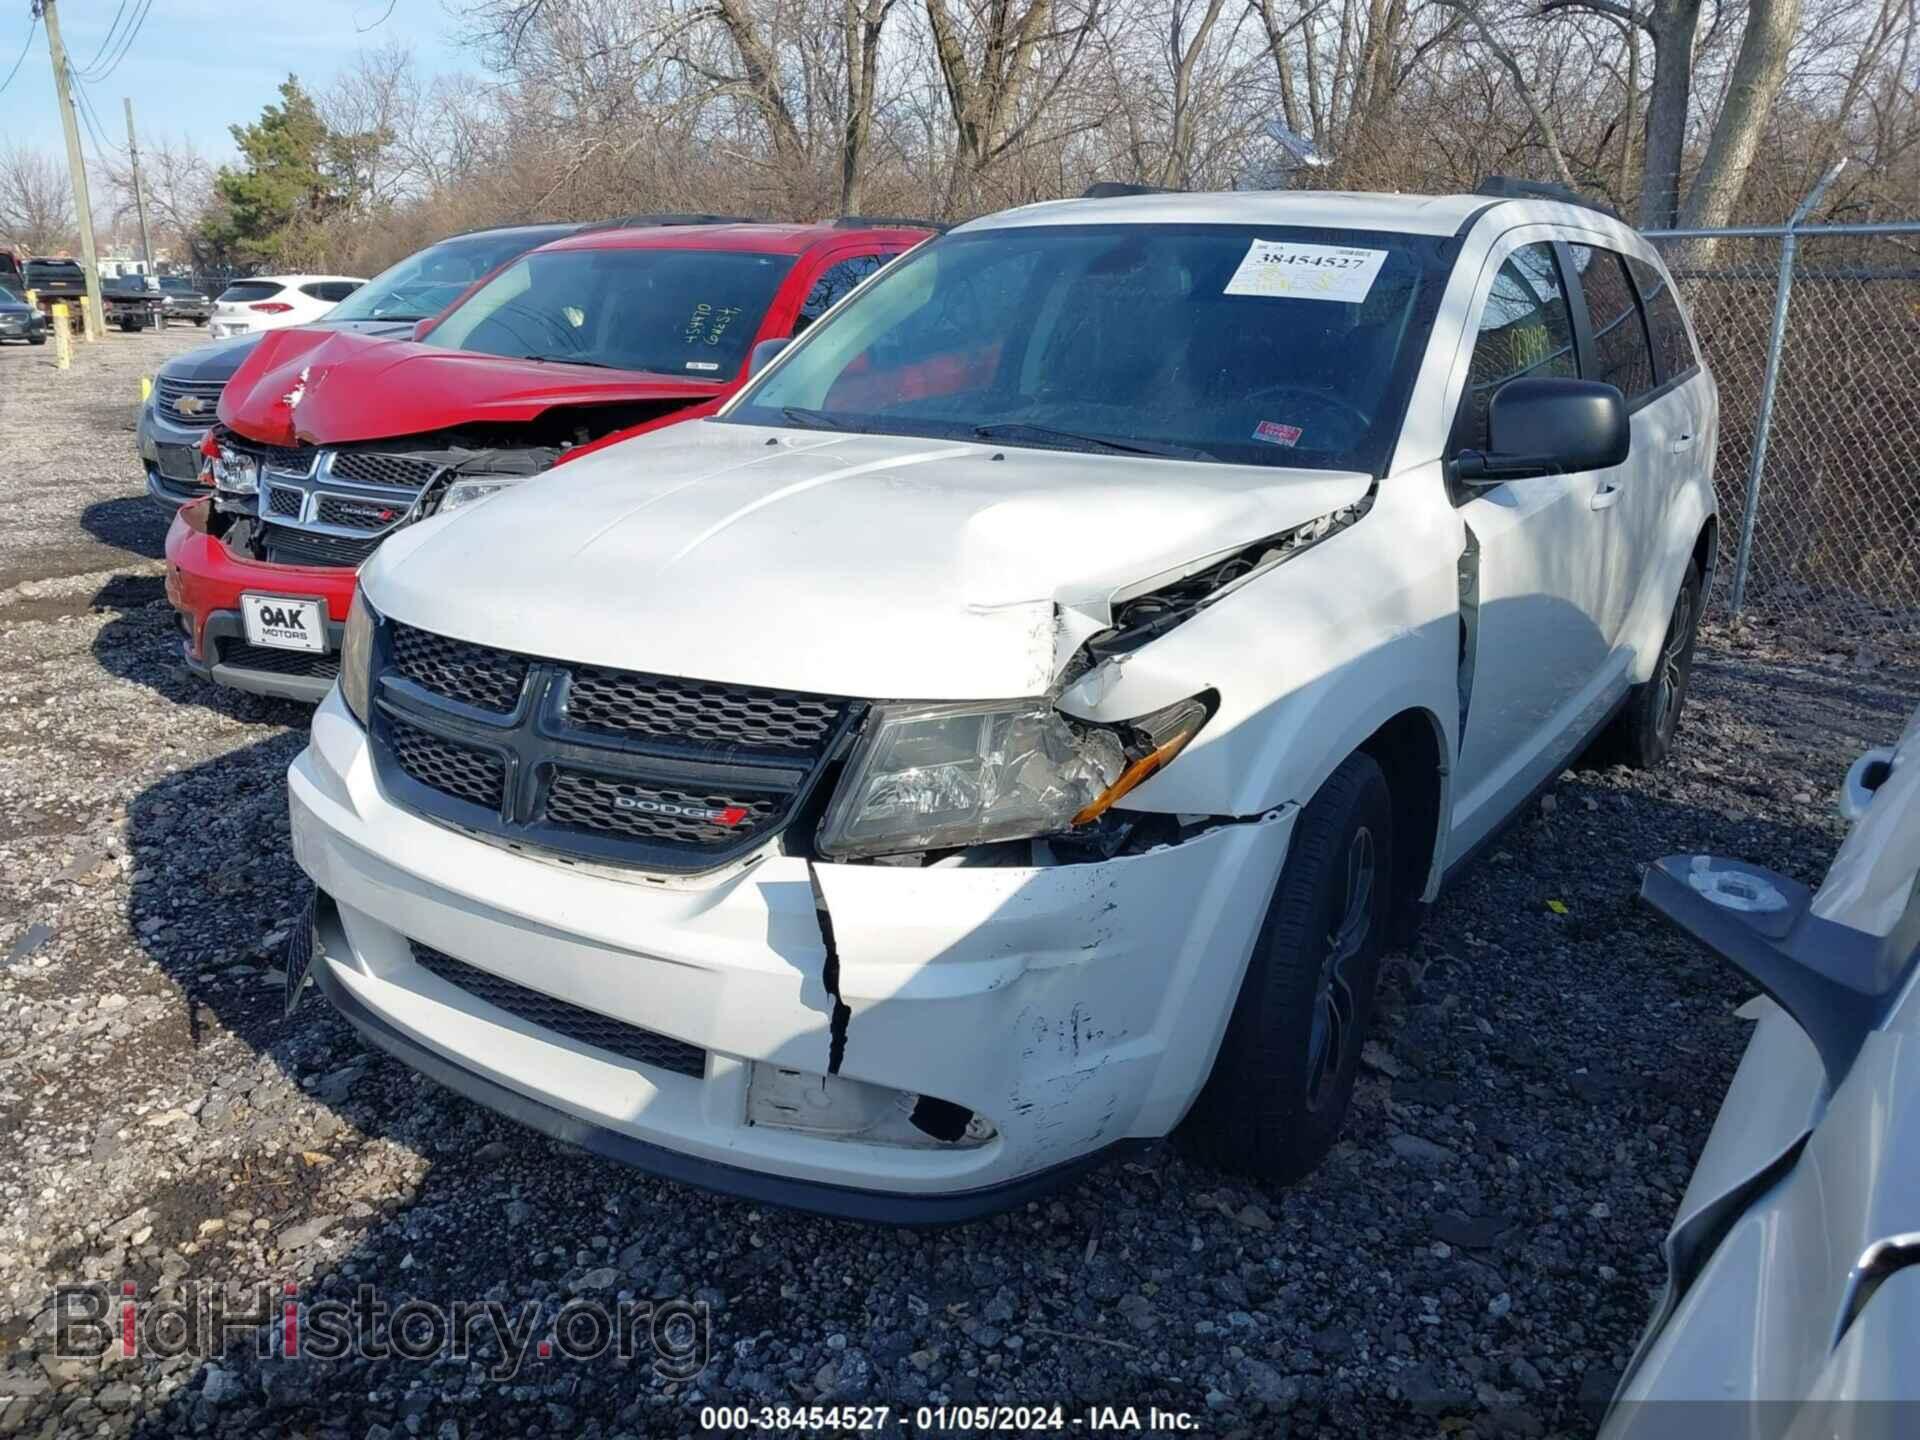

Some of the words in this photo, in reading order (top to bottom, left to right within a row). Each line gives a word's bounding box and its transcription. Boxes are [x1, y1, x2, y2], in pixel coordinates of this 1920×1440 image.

[1256, 252, 1365, 269] 38454527
[260, 605, 305, 630] OAK
[262, 628, 308, 641] MOTORS
[614, 796, 726, 820] DODGE
